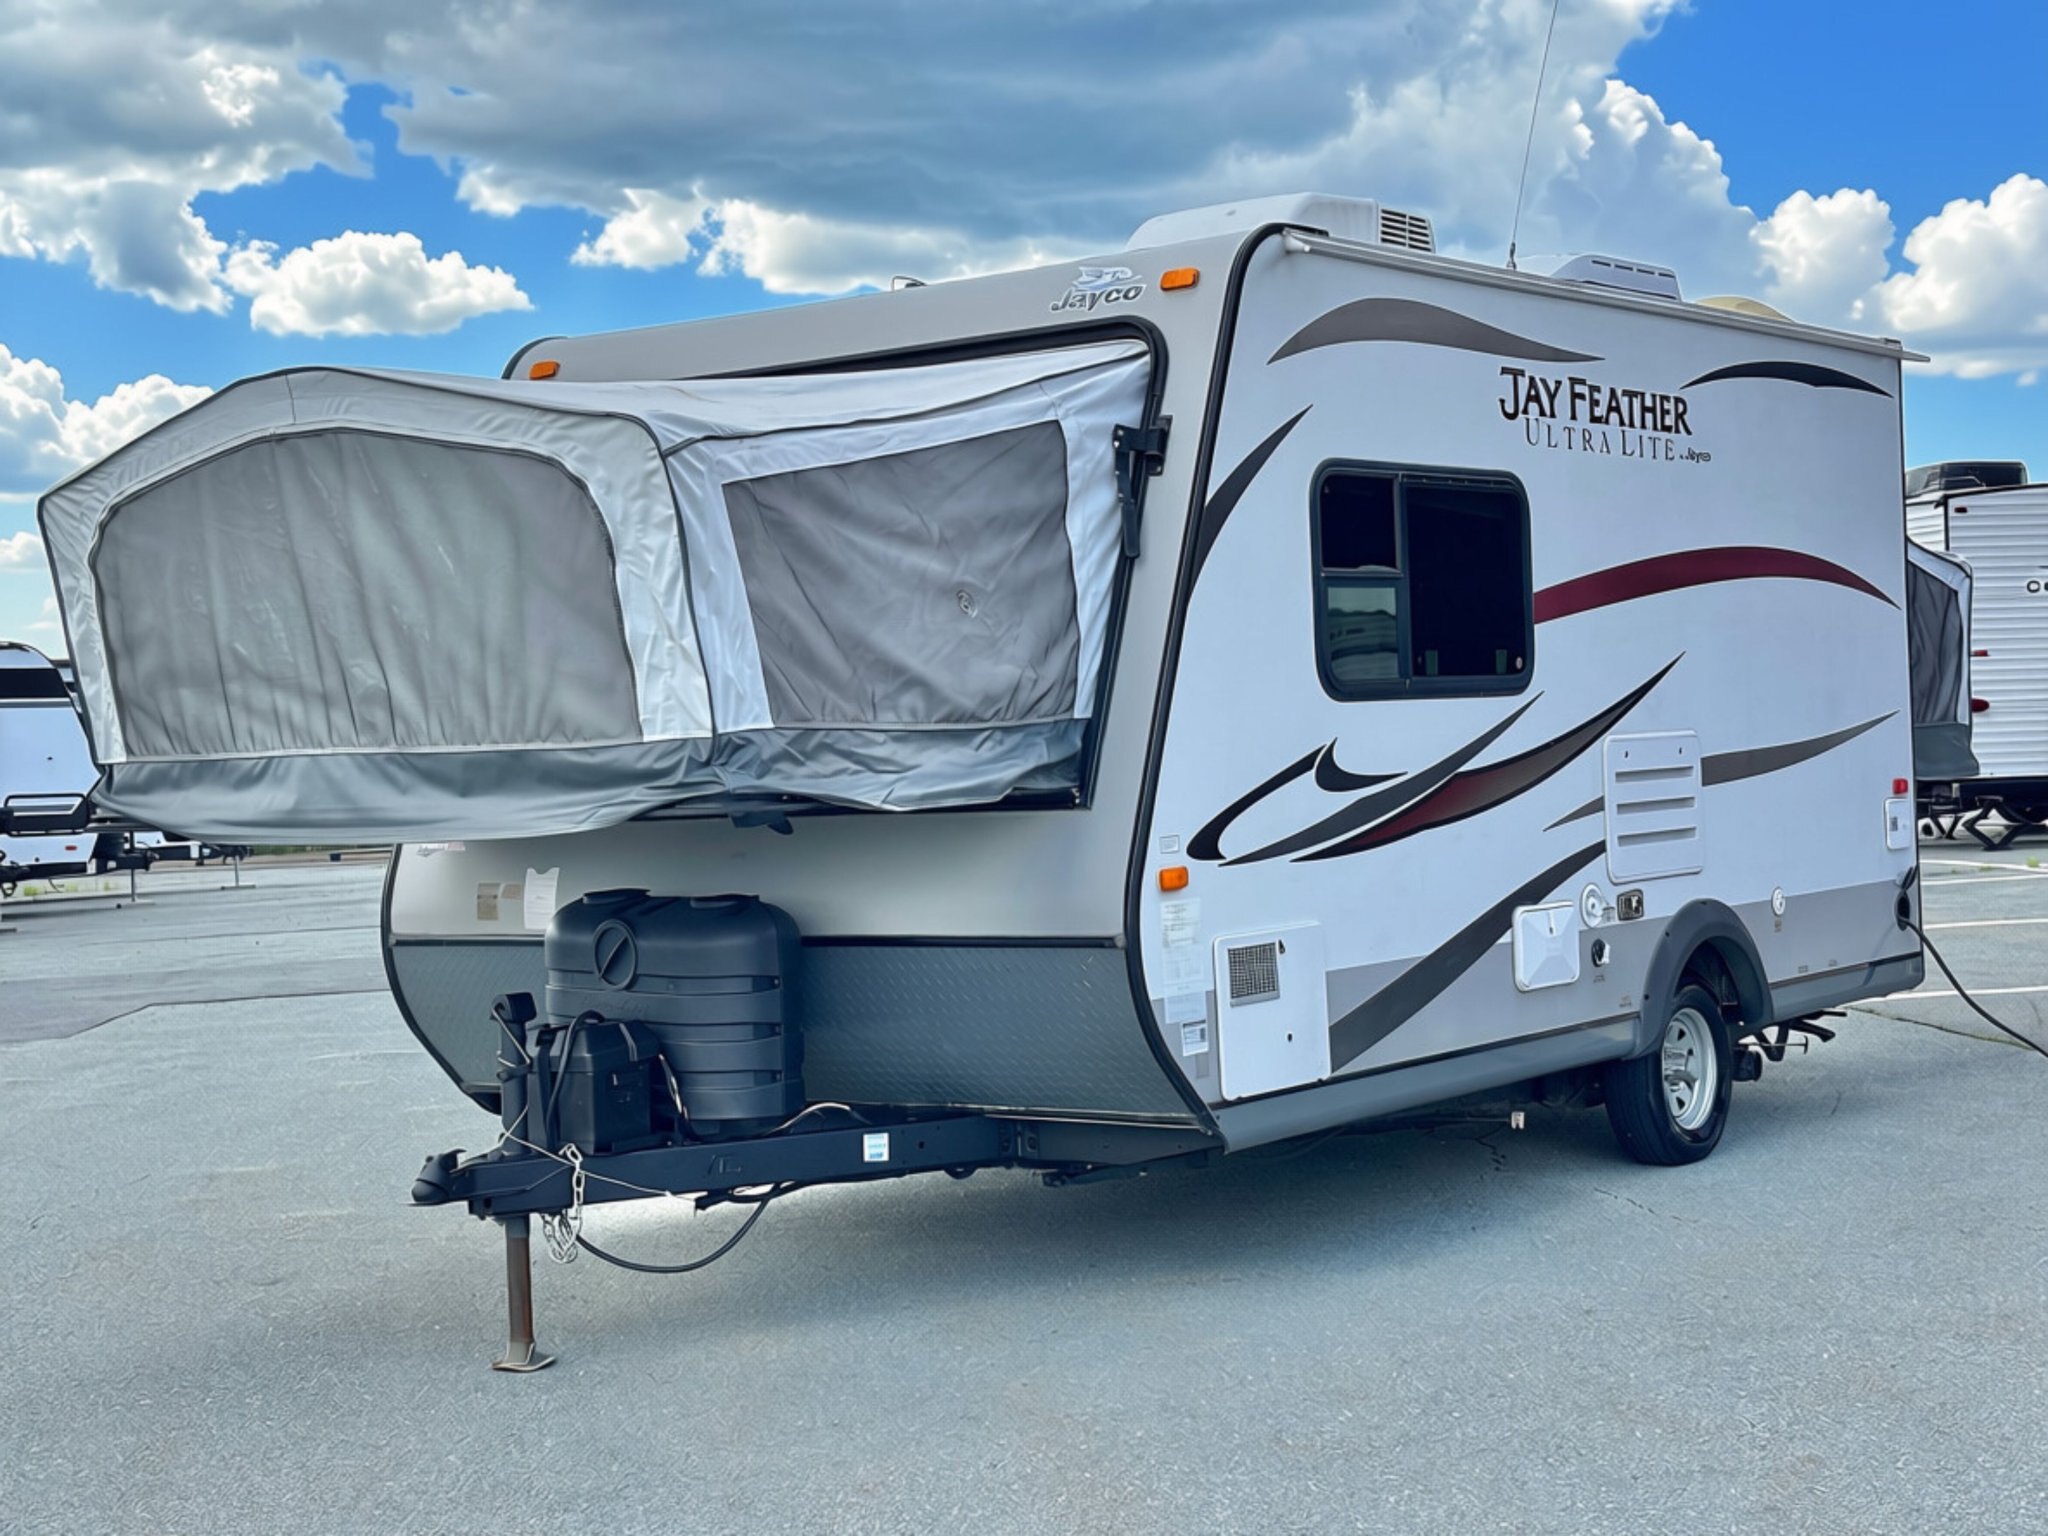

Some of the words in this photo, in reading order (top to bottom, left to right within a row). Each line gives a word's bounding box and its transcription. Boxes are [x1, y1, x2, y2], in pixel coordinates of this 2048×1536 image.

[1050, 284, 1146, 312] Jayco
[1498, 365, 1563, 421] JAY
[1567, 376, 1692, 436] FEATHER
[1524, 417, 1611, 456] ULTRA
[1620, 429, 1676, 462] LITE
